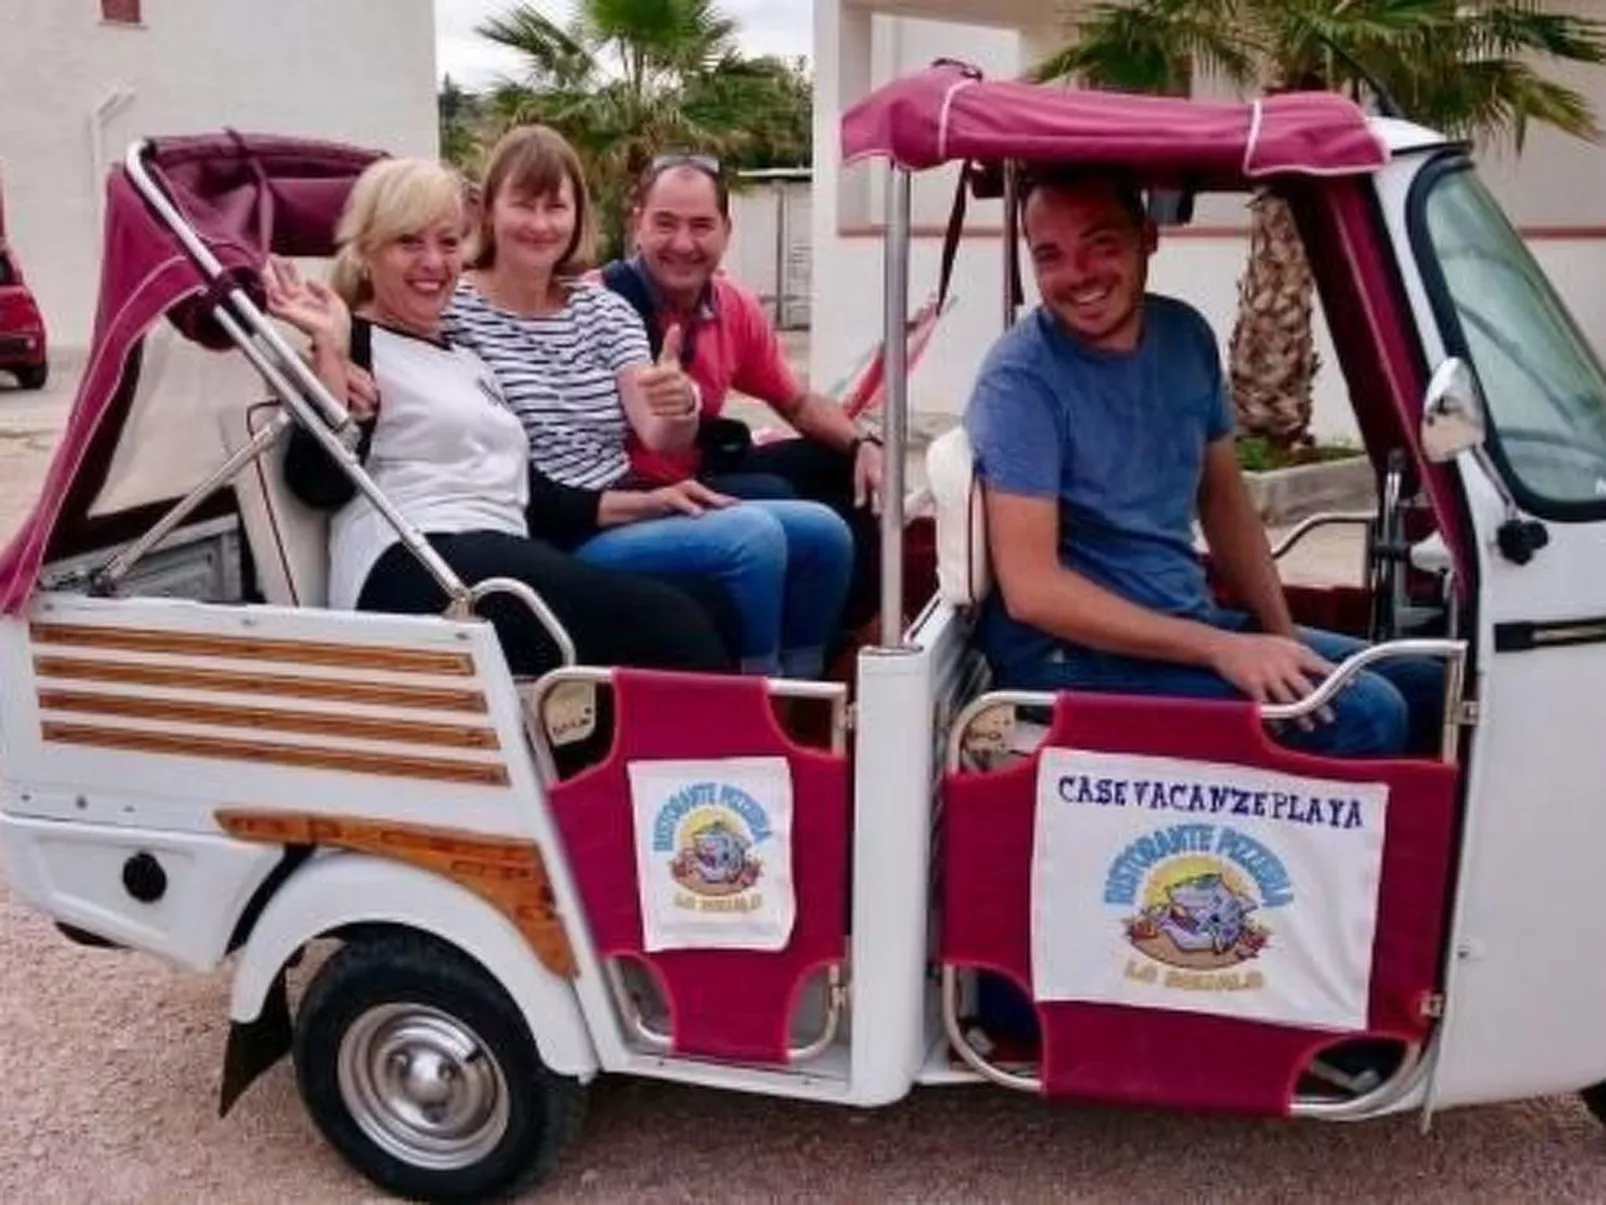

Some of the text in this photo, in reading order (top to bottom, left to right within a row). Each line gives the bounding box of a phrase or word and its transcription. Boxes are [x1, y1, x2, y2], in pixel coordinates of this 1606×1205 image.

[1058, 775, 1127, 806] CASE
[1104, 823, 1295, 907] RISTORANTE PIZZERIA
